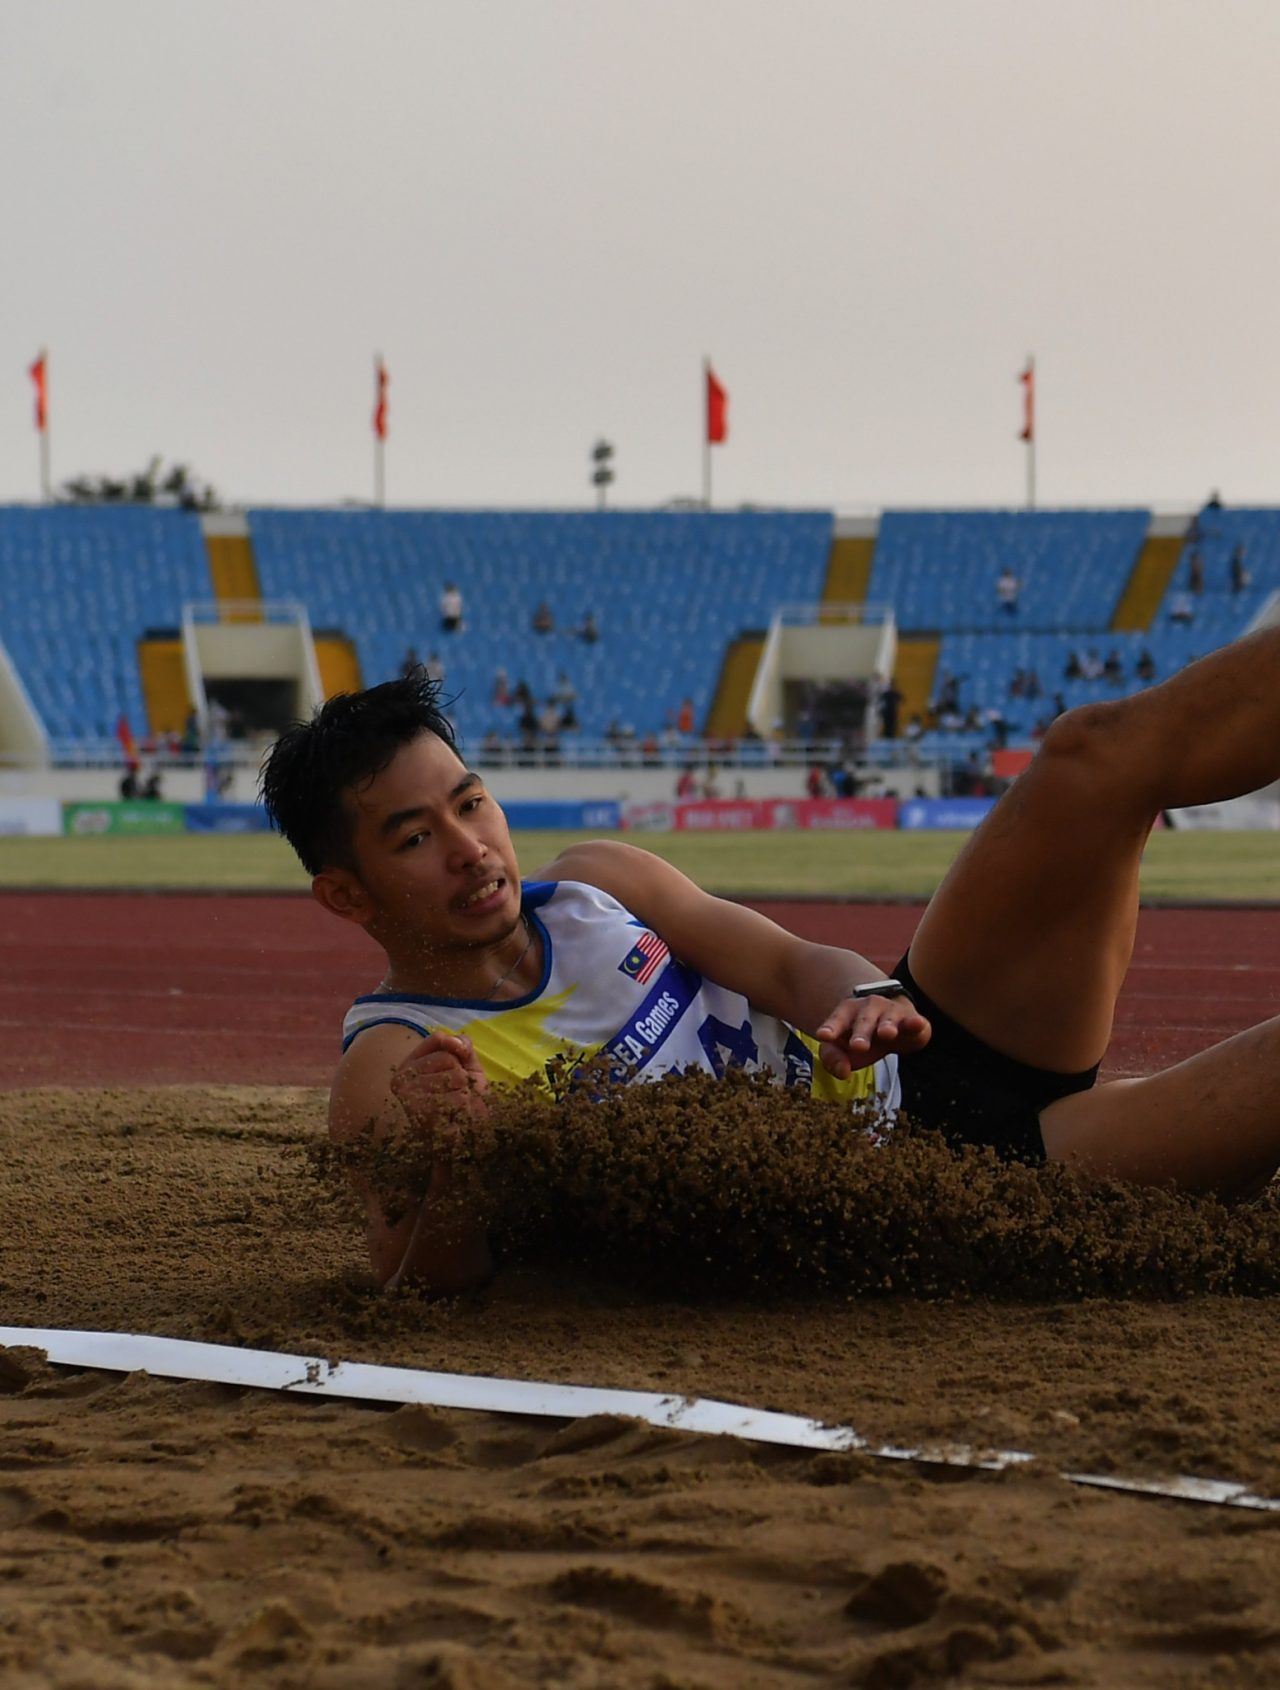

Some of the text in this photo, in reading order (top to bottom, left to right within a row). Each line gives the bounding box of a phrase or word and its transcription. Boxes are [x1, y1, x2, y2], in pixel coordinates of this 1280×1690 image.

[607, 991, 679, 1077] SEA Games
[672, 1013, 758, 1081] 4
